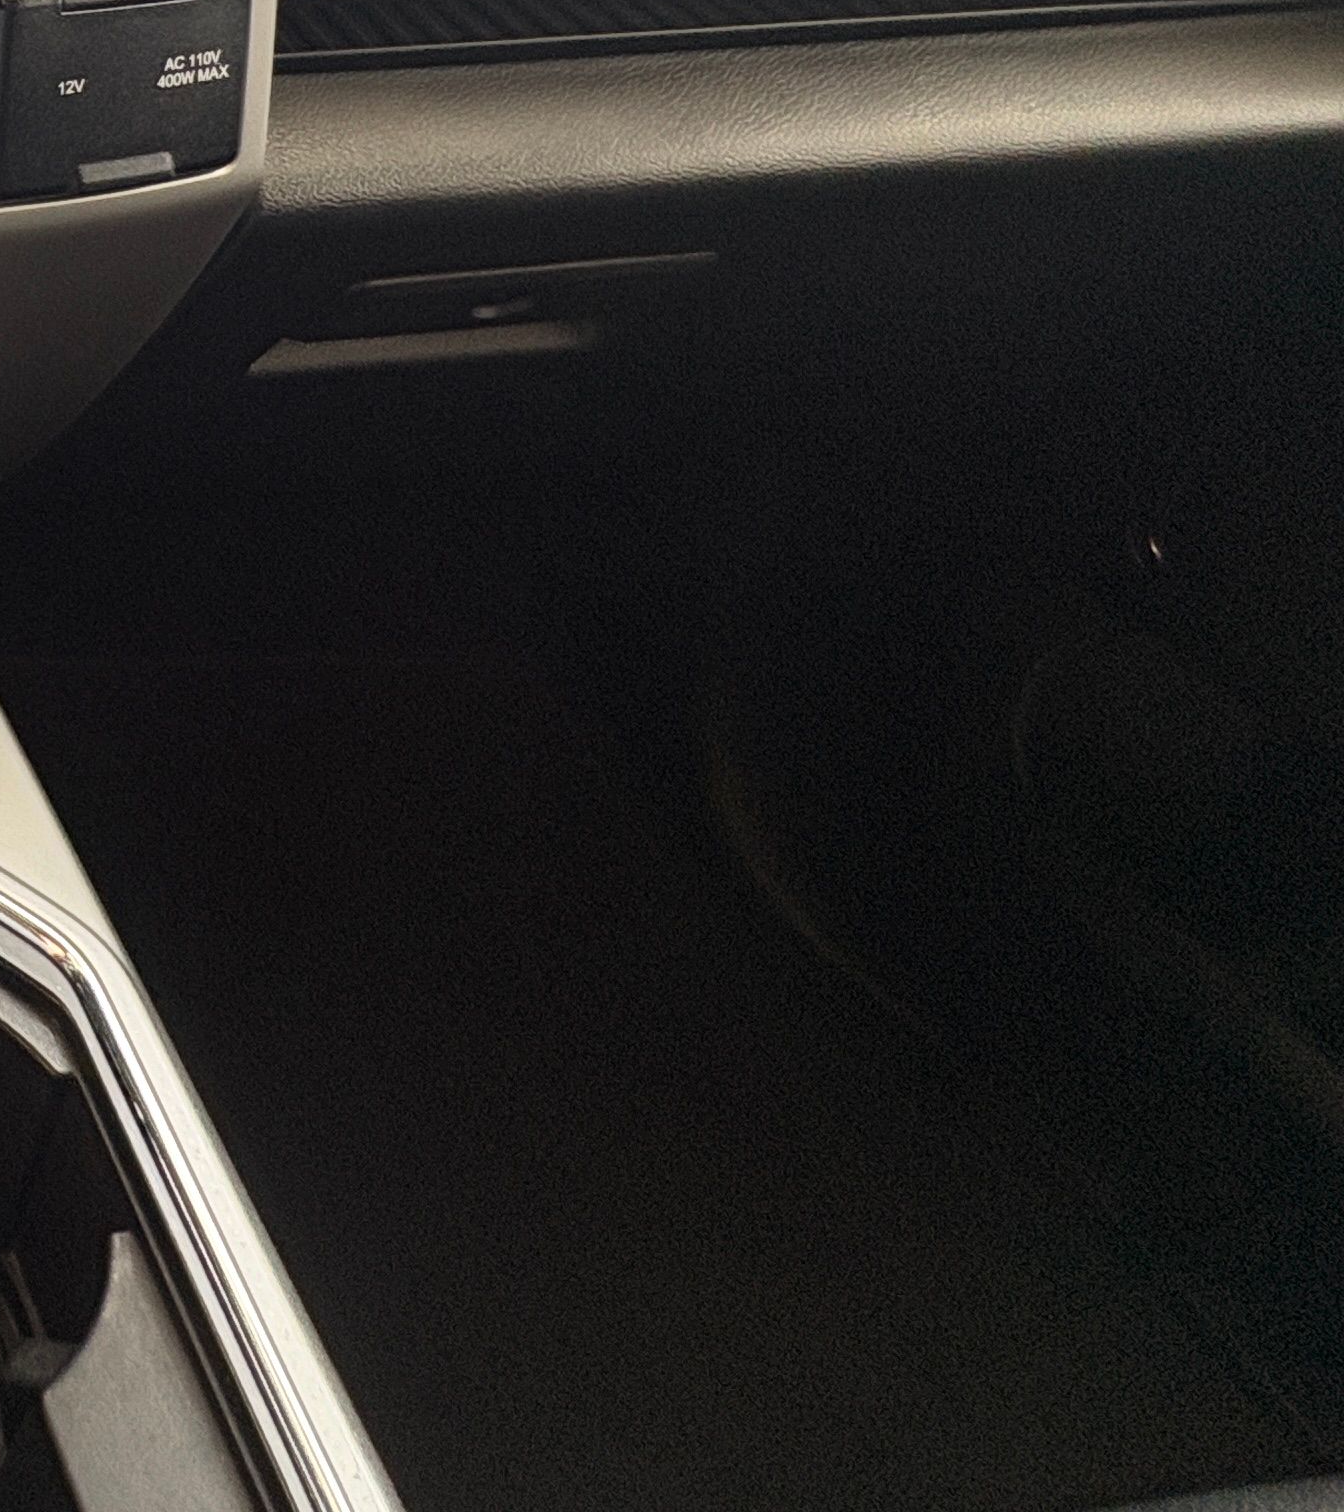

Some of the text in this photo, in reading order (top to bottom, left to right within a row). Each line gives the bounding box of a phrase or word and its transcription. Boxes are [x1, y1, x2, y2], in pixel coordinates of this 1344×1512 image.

[164, 49, 223, 71] AC 110V
[58, 79, 85, 96] 12V
[157, 64, 230, 89] 400W MAX
